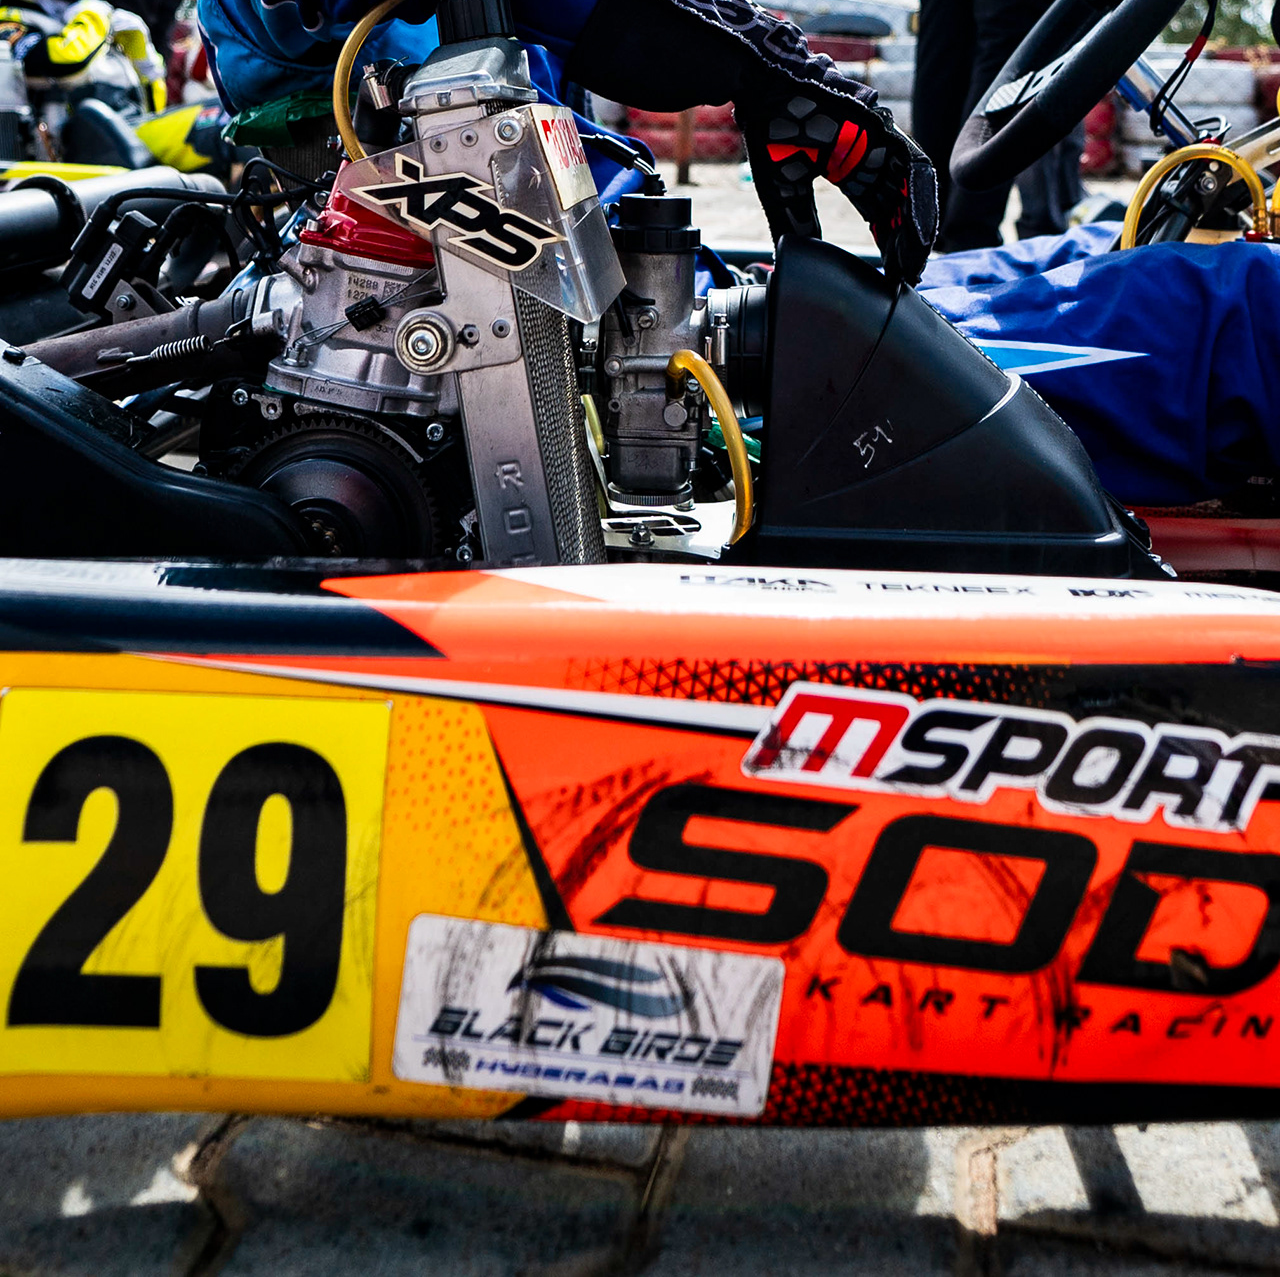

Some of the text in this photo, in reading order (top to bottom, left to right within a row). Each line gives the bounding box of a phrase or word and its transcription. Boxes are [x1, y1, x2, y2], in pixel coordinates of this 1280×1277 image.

[5, 733, 349, 1038] 29
[805, 973, 1014, 1020] KART
[428, 1006, 744, 1069] BLACK BIRDS
[473, 1057, 687, 1096] HYDERABAD
